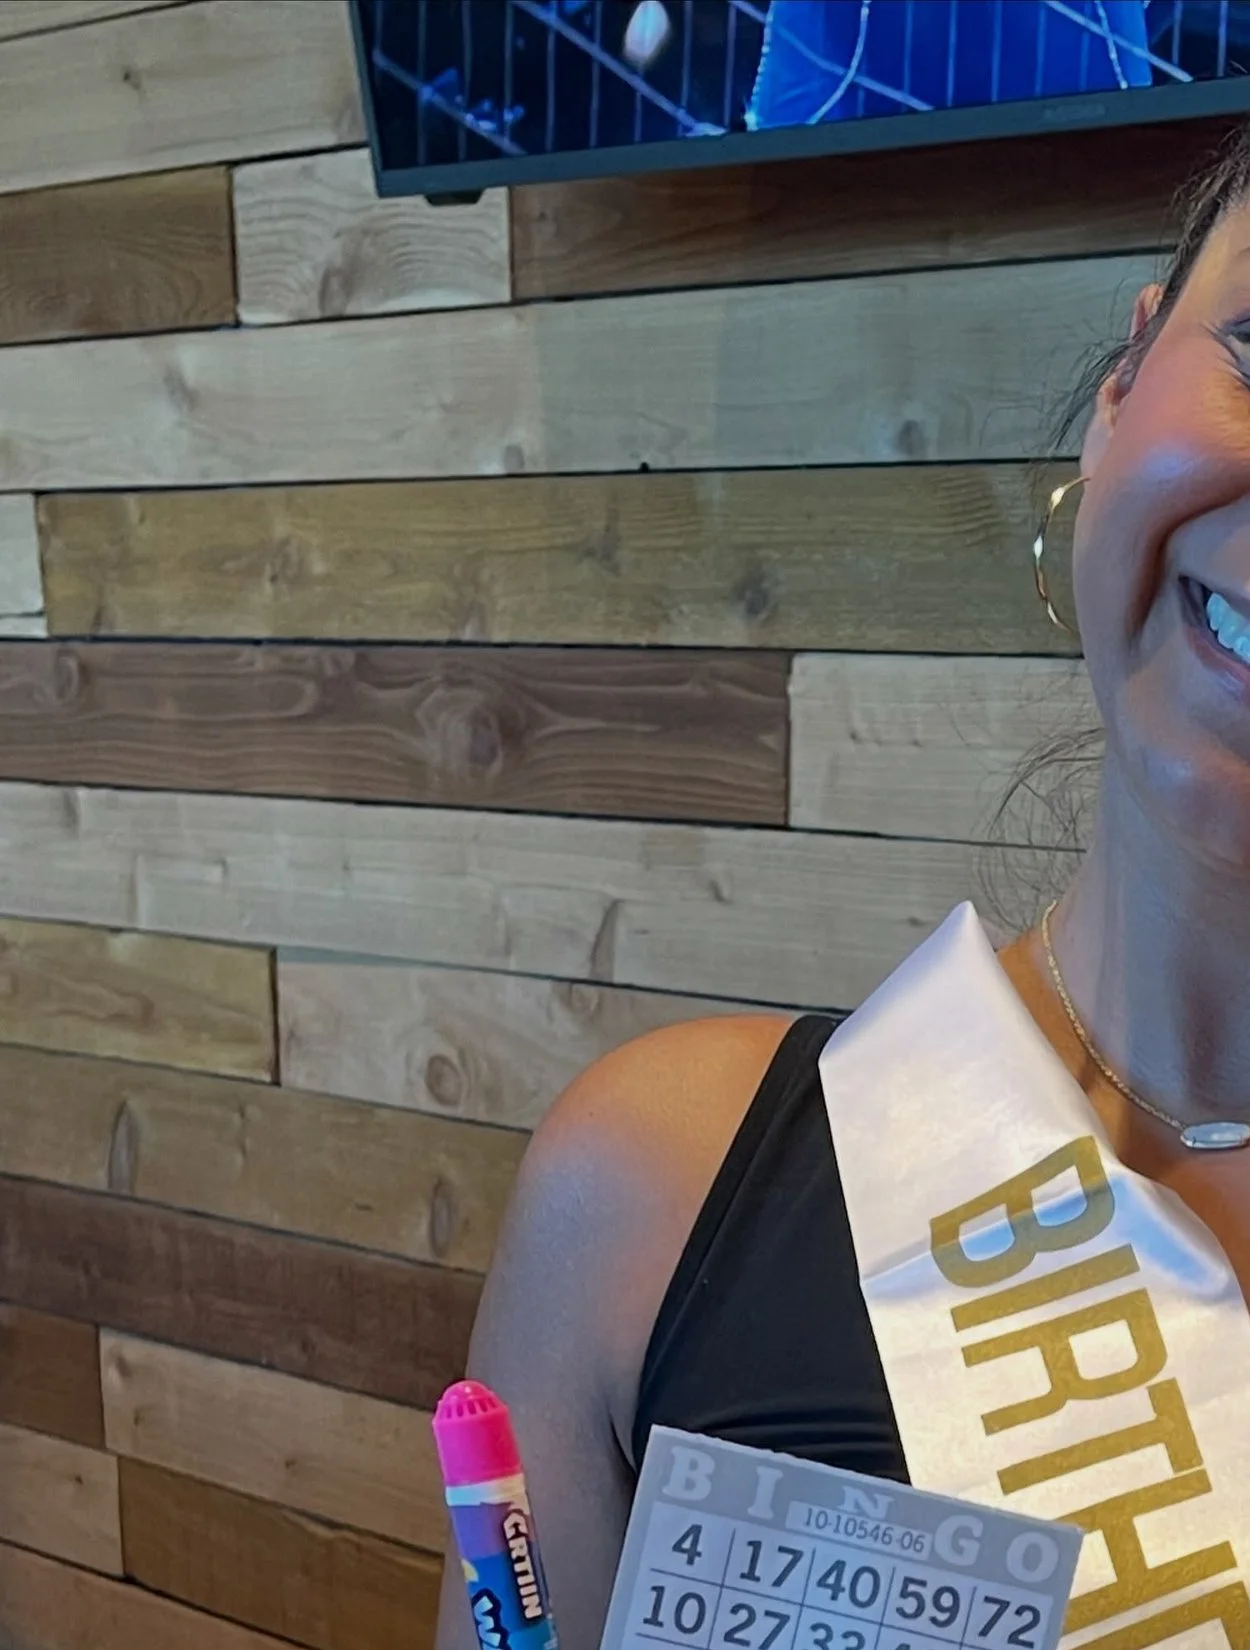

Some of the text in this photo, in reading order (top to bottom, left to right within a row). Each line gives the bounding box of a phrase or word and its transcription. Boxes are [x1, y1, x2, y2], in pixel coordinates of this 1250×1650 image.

[642, 1585, 706, 1635] 10
[672, 1524, 1041, 1649] 4 17 40 59 72
